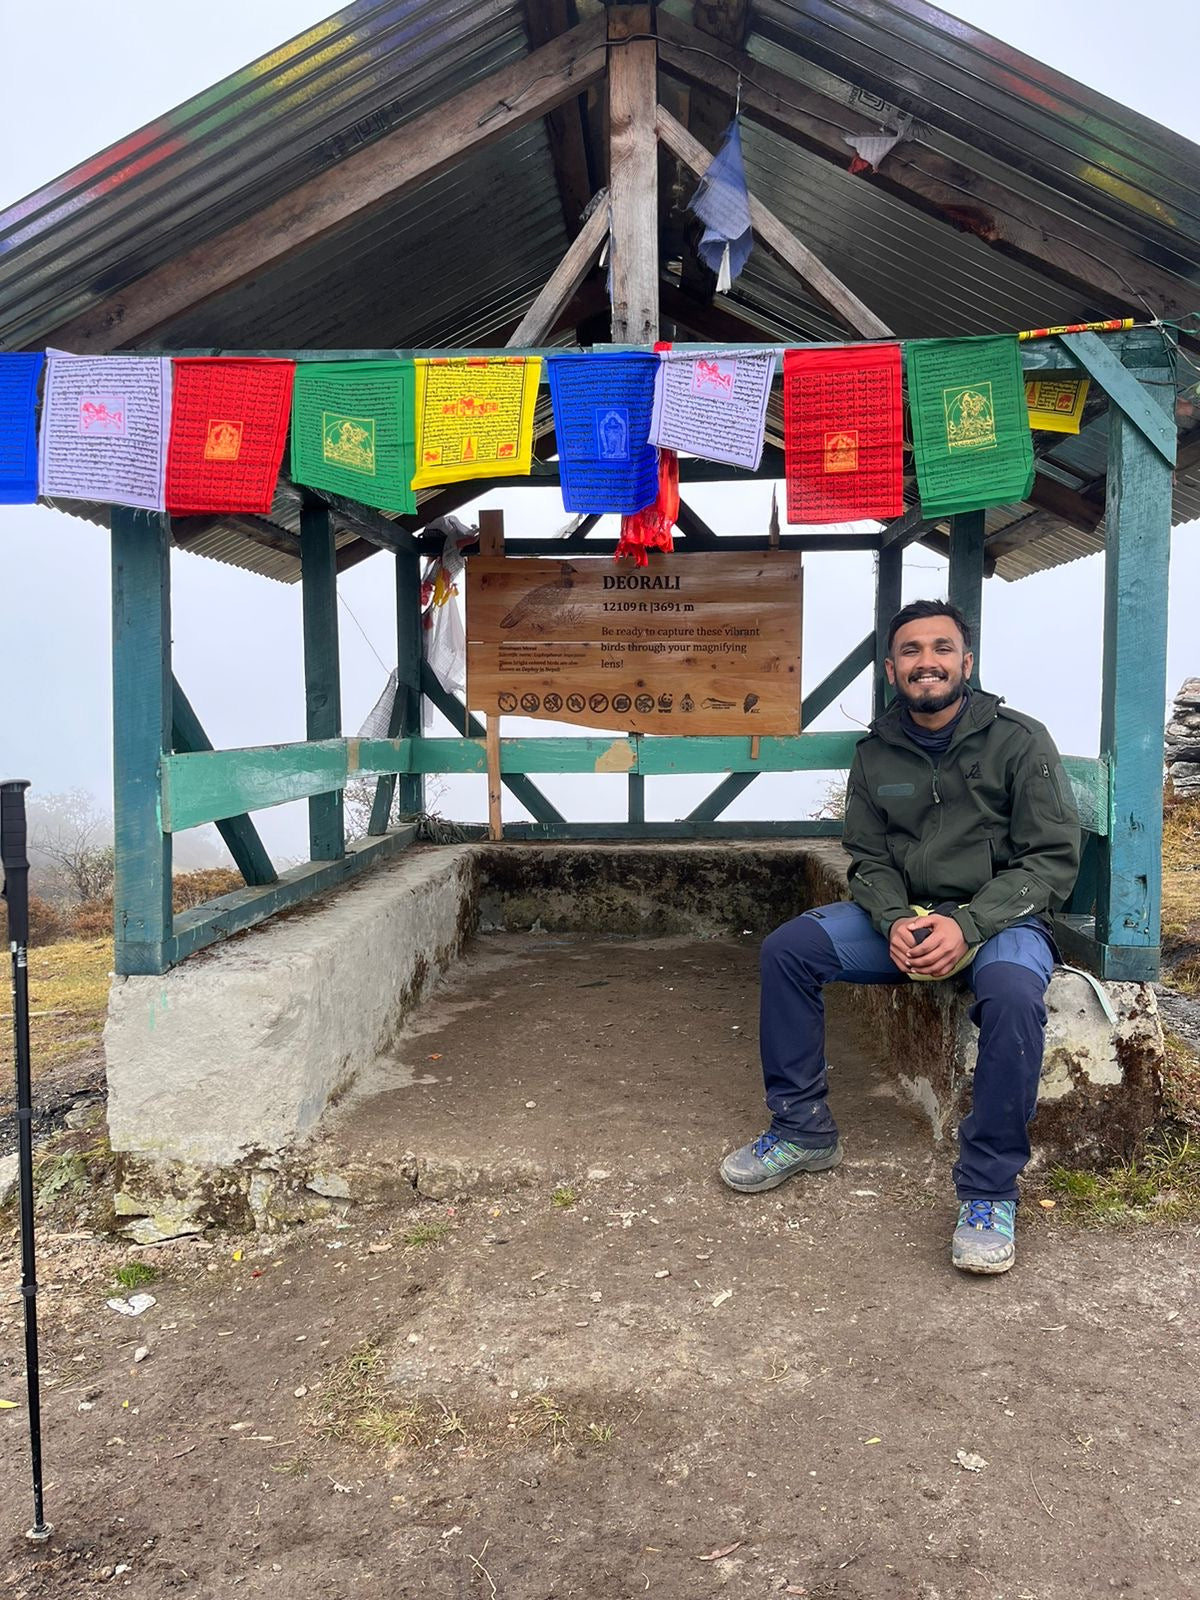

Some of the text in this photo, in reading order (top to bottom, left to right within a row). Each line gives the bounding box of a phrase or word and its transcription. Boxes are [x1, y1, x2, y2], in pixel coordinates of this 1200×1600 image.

[602, 575, 681, 590] DEORALI
[602, 602, 637, 612] 12109
[638, 602, 648, 612] ft
[683, 604, 695, 612] m
[601, 626, 761, 638] Be ready to capture these vibrant
[600, 642, 747, 654] birds through your magnifying
[600, 659, 624, 669] lens!
